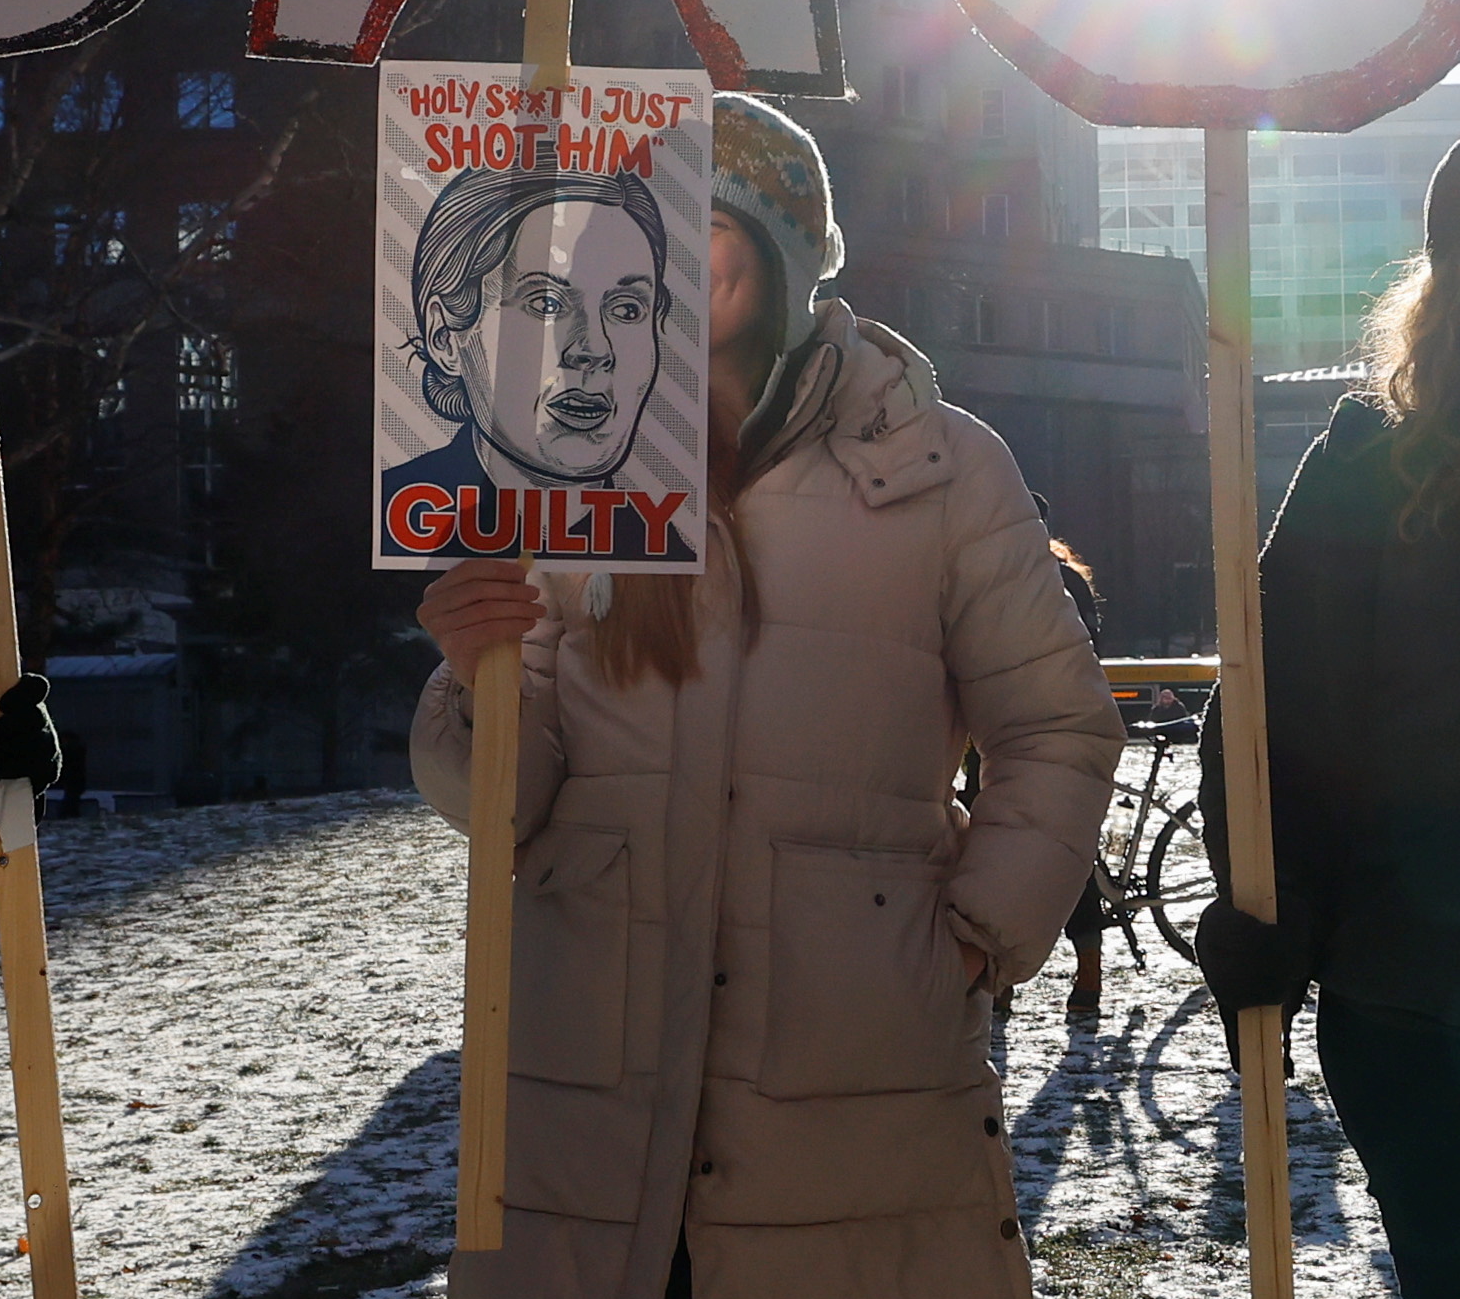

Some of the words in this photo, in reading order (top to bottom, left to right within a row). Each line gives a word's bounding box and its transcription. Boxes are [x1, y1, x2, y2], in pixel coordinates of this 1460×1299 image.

[582, 85, 592, 119] I
[600, 87, 692, 129] JUST
[426, 122, 548, 173] SHOT
[385, 482, 691, 556] GUILTY
